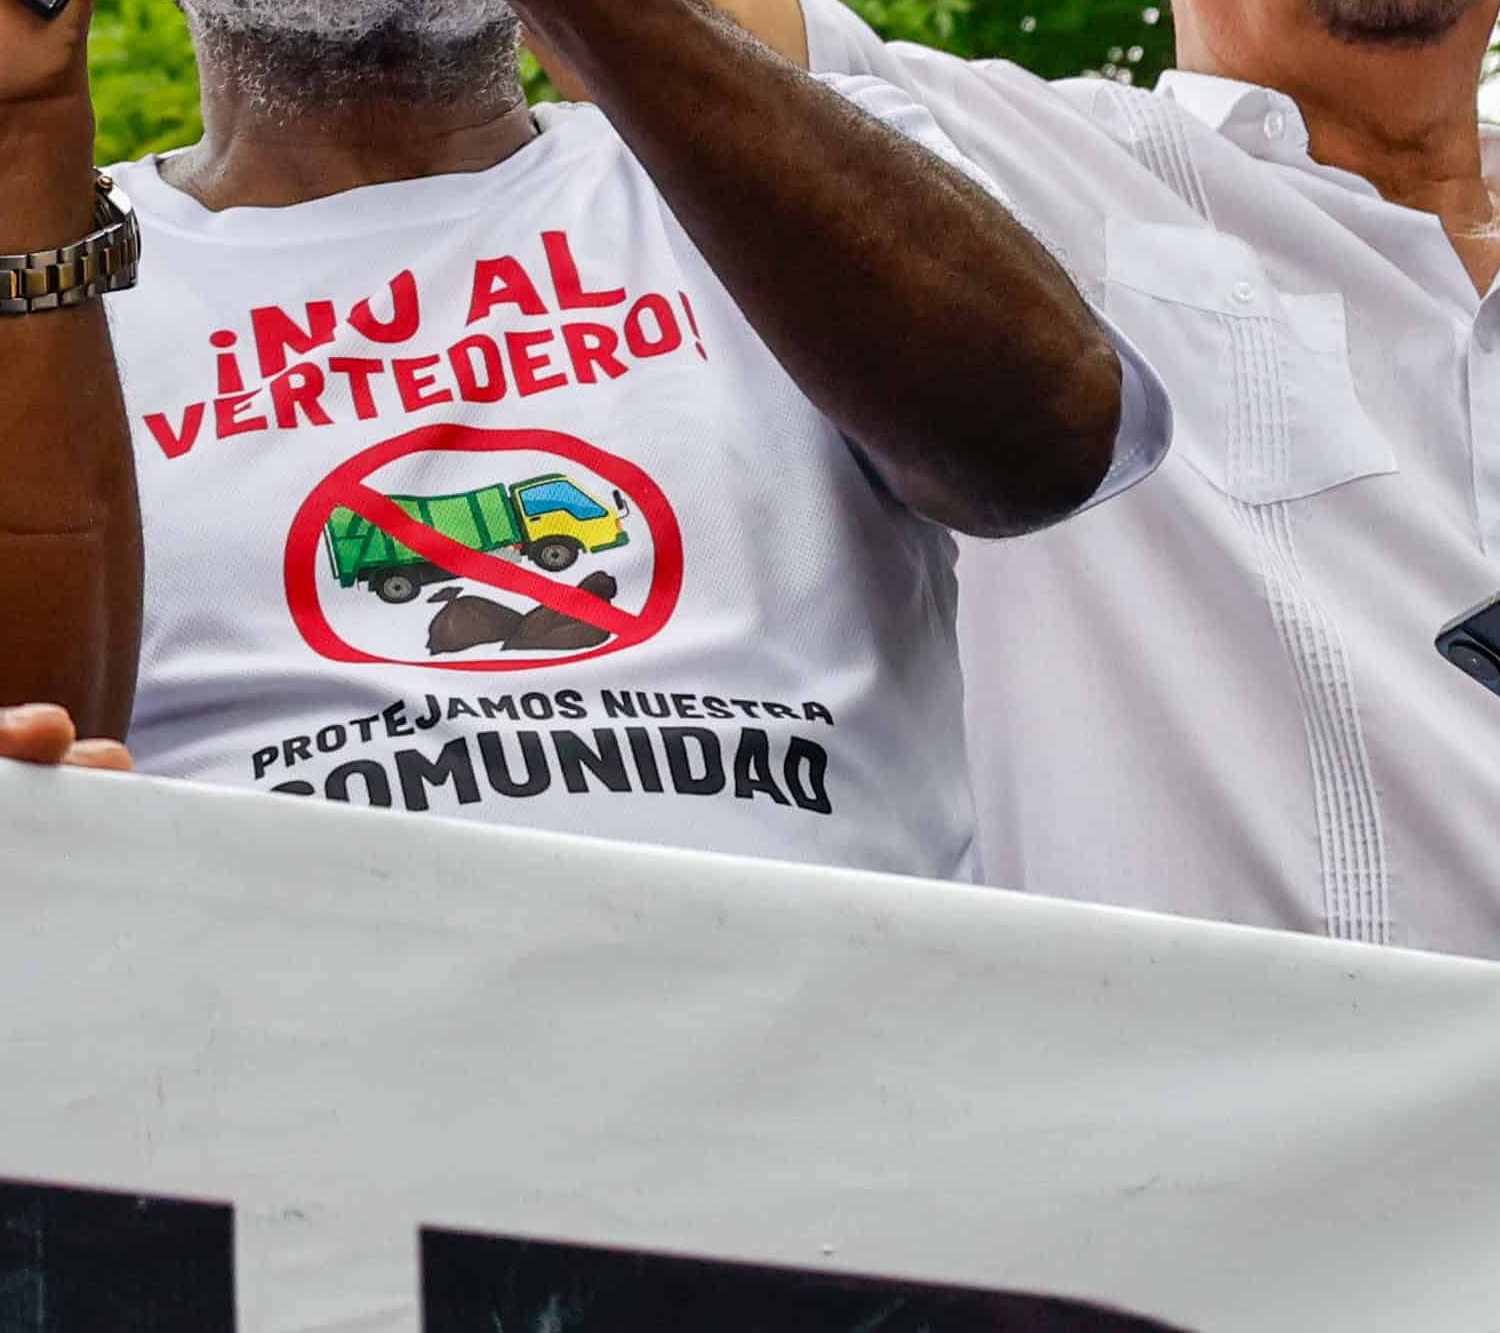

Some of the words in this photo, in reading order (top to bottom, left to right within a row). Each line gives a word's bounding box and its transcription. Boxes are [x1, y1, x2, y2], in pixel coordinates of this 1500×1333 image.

[465, 228, 629, 327] AL
[142, 289, 708, 461] VERTEDERO!
[250, 688, 589, 781] PROTEJAMOS
[599, 688, 836, 728] NUESTRA
